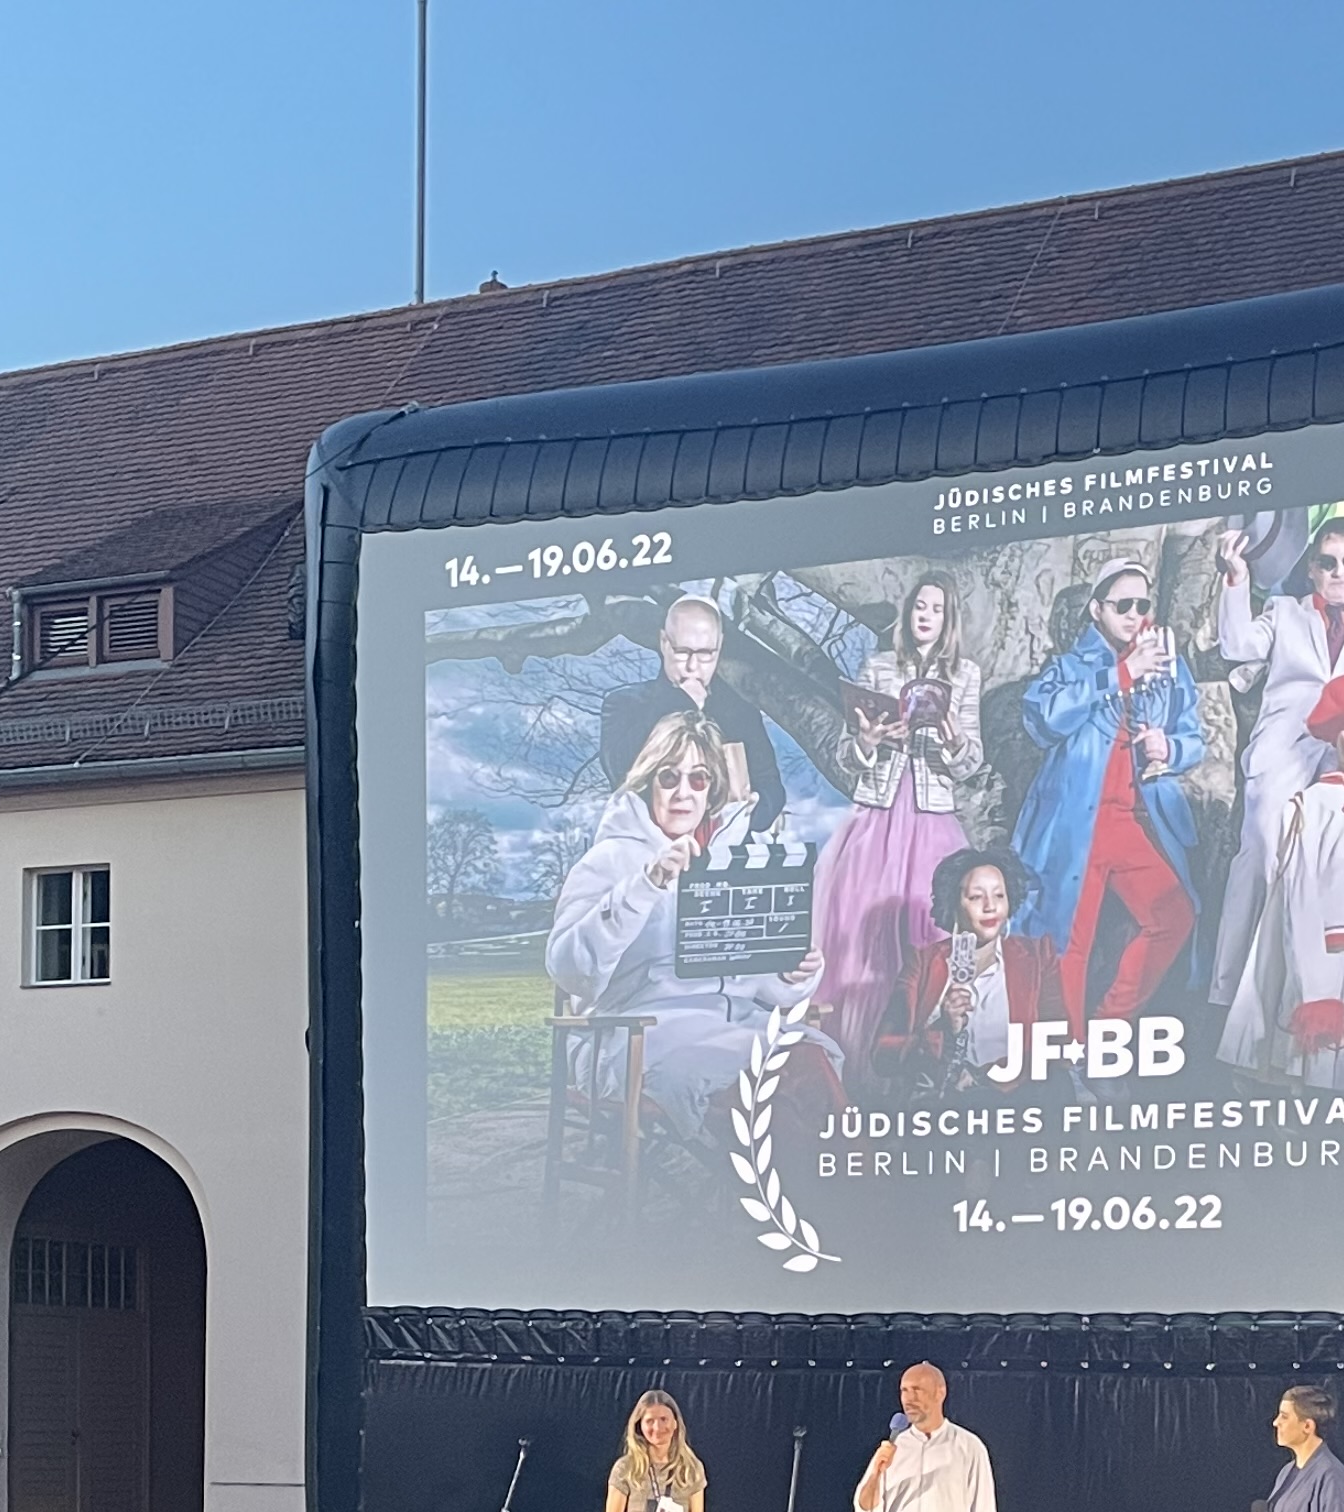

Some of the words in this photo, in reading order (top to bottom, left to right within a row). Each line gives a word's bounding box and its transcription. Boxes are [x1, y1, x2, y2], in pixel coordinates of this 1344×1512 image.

[933, 477, 1073, 511] JÜDISCHES
[1084, 451, 1273, 492] FILMFESTIVAL
[933, 508, 1025, 535] BERLIN
[1064, 477, 1272, 518] BRANDENBURG
[819, 1106, 1043, 1139] JÜDISCHES
[819, 1150, 965, 1177] BERLIN
